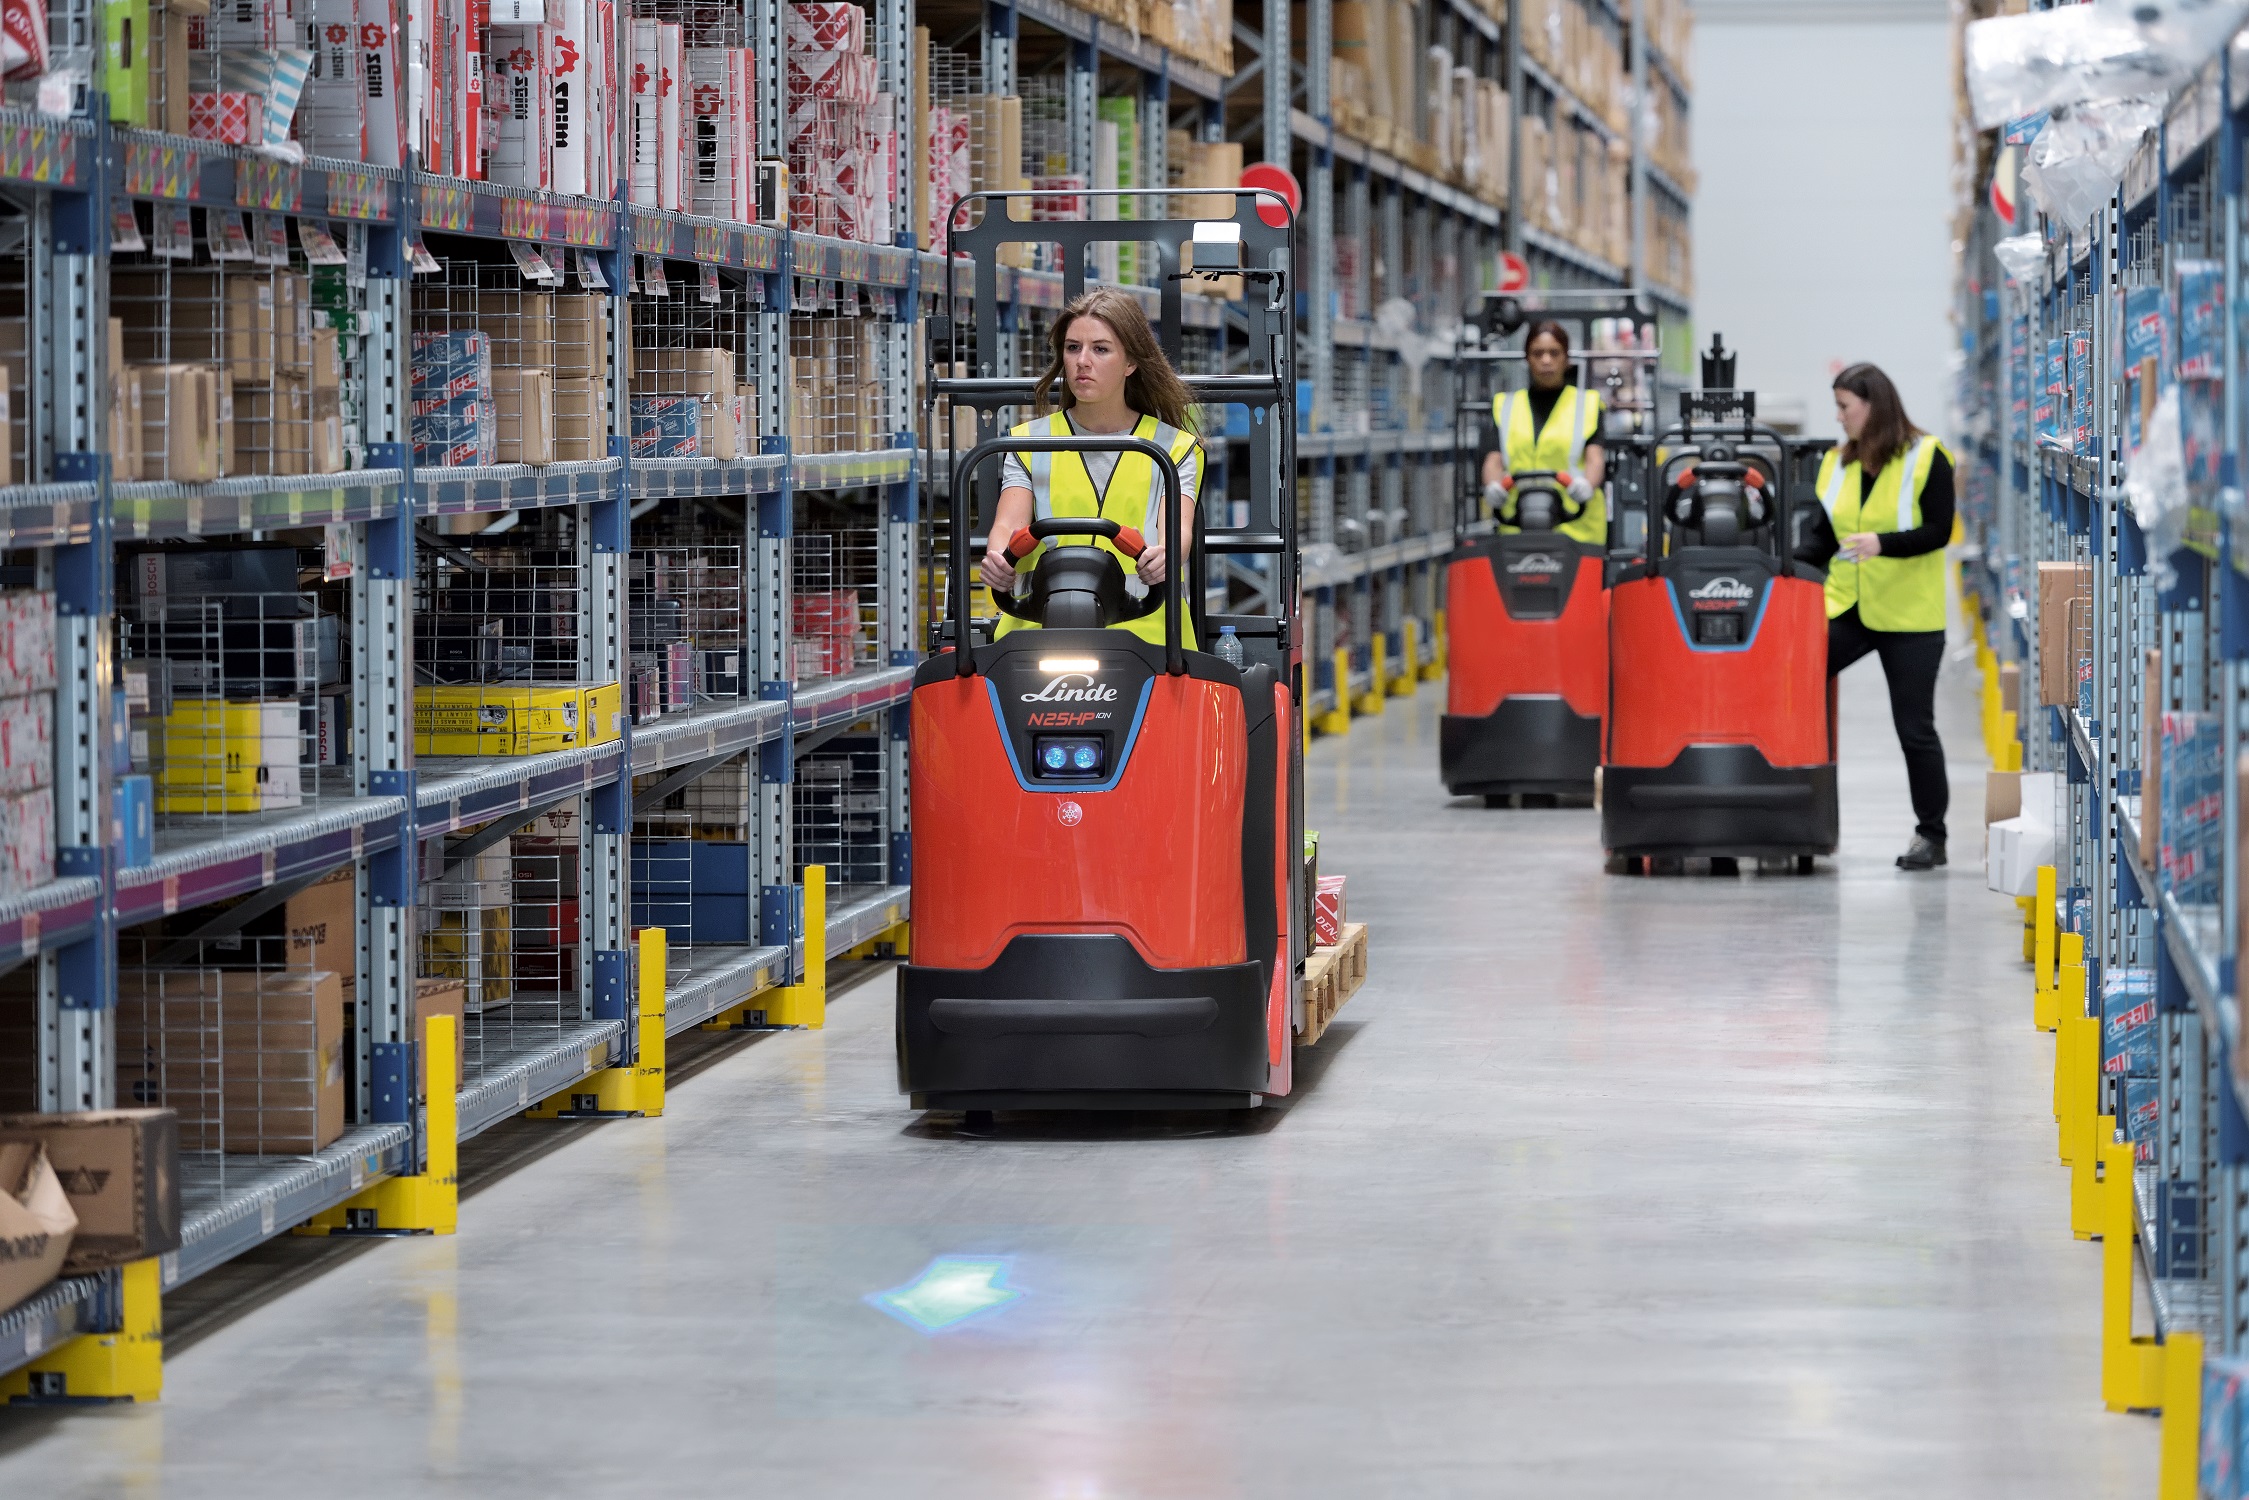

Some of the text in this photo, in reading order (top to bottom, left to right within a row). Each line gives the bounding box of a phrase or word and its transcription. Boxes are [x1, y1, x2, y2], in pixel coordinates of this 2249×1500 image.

[147, 557, 158, 597] BOSCH
[1689, 577, 1754, 599] Linde
[1020, 673, 1118, 702] Linde
[1027, 712, 1096, 726] N25HP
